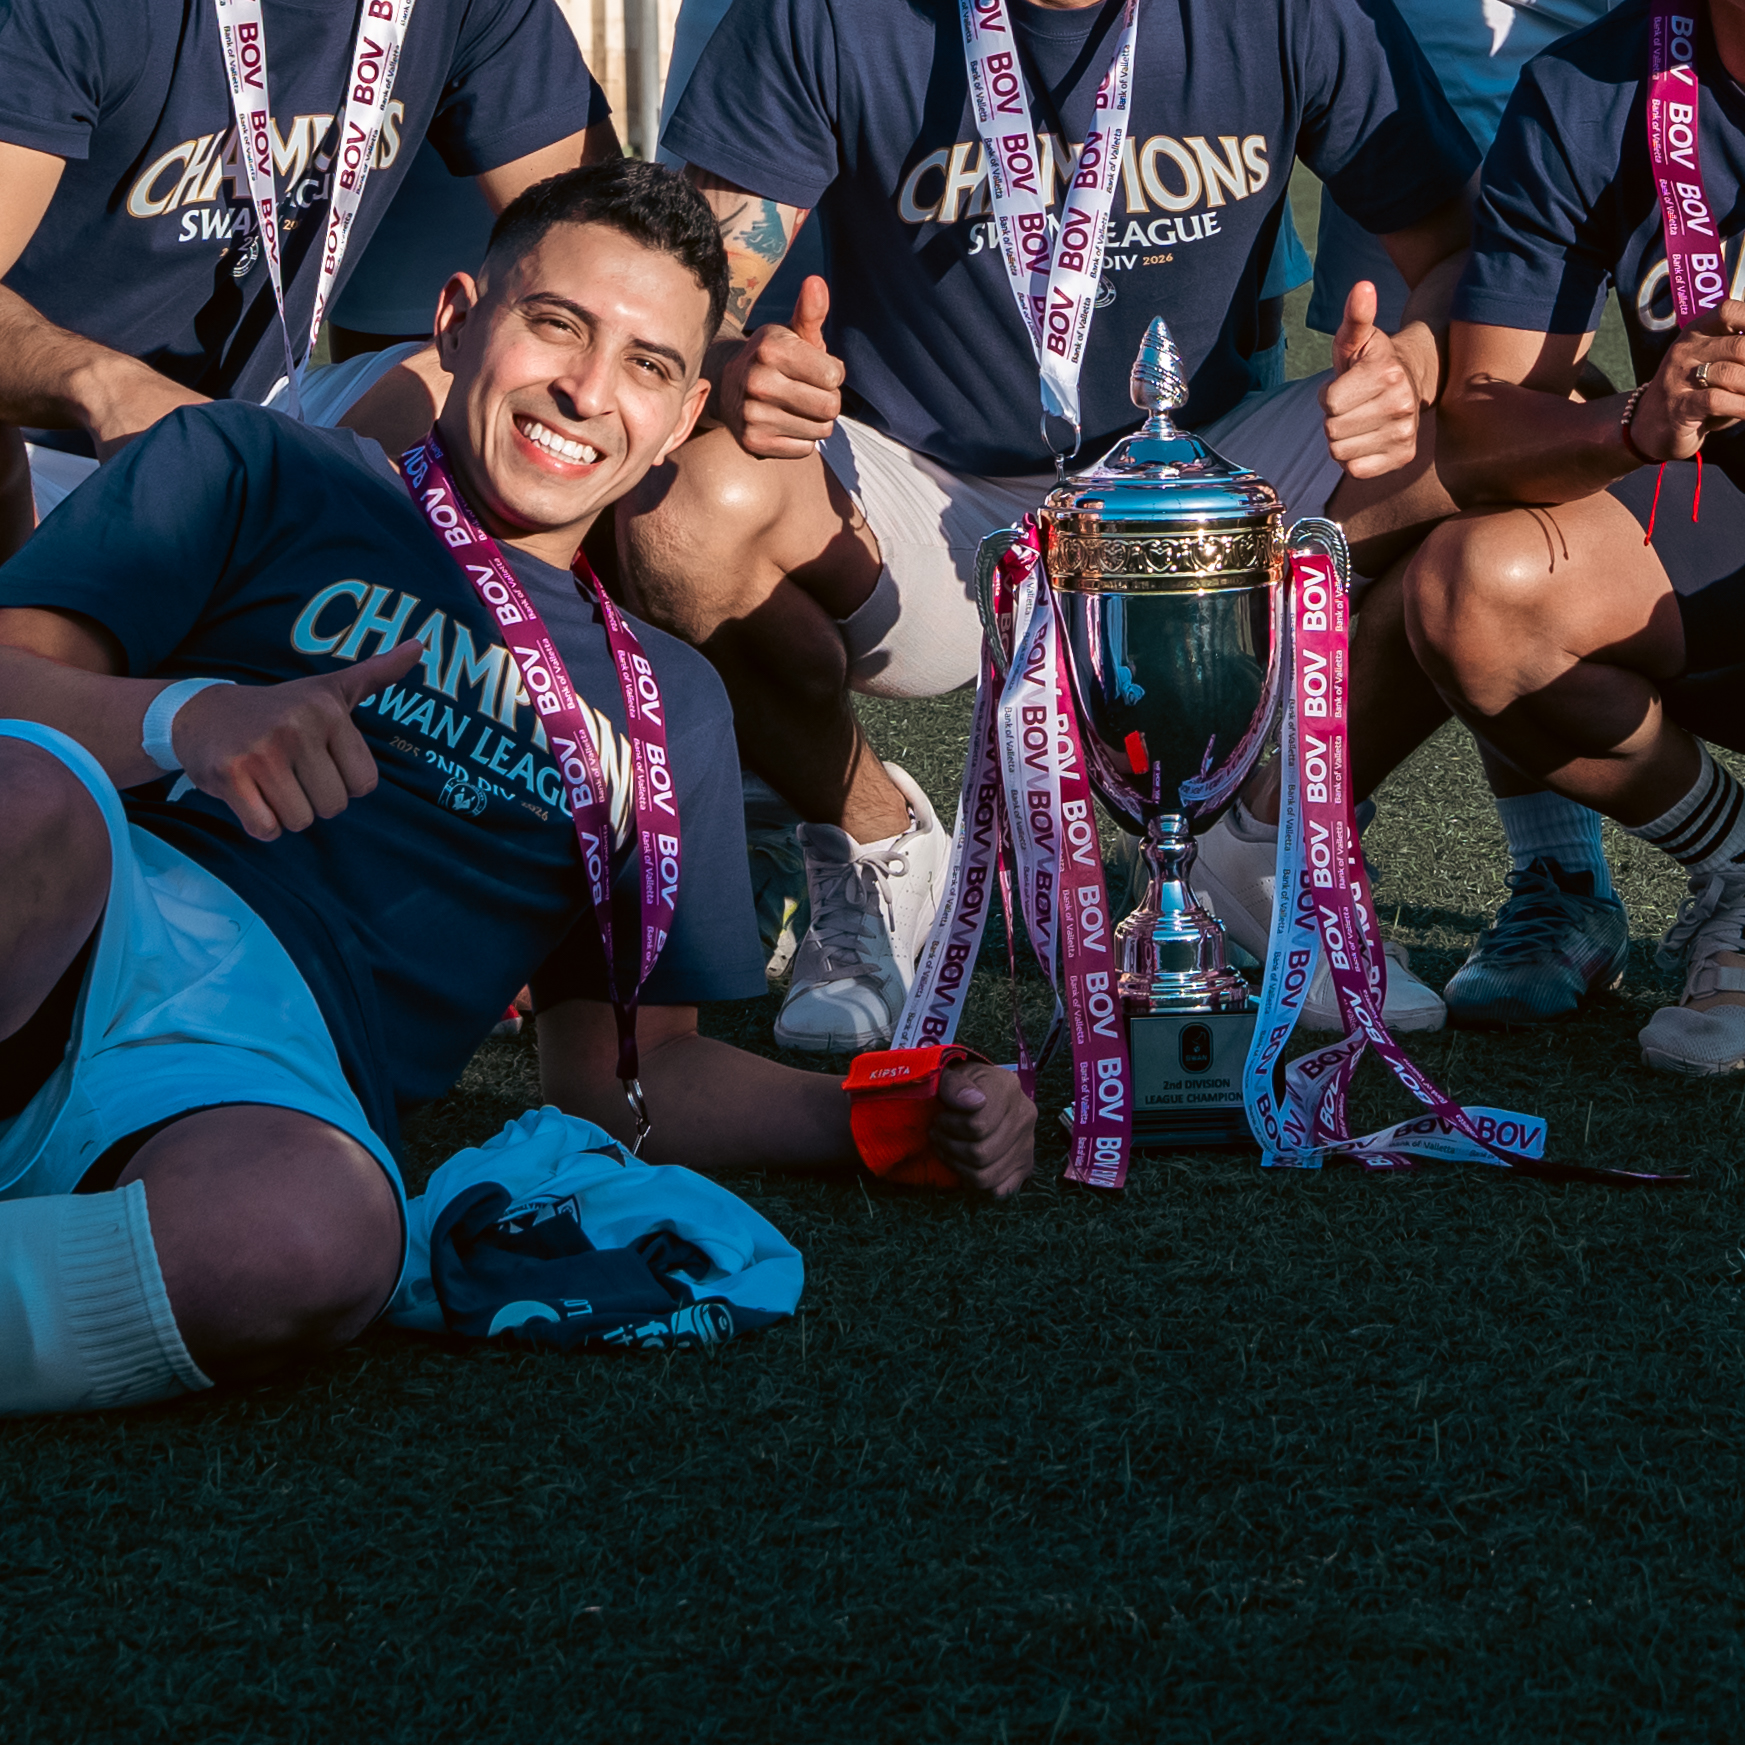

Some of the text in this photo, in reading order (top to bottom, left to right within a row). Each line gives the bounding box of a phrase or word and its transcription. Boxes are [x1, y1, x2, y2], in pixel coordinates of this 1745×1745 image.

[238, 23, 263, 89] BOV
[353, 36, 384, 106] BOV
[1671, 15, 1694, 86] BOV
[987, 52, 1023, 115] BOV
[251, 111, 271, 177] BOV
[340, 121, 366, 191] BOV
[1002, 133, 1037, 195] BOV
[1668, 102, 1695, 170] BOV
[261, 199, 278, 264] BOV
[1058, 207, 1091, 273] BOV
[1676, 181, 1714, 236] BOV
[324, 207, 341, 275] BOV
[1018, 213, 1050, 276] BOV
[1142, 253, 1174, 266] 2026
[1047, 286, 1074, 357] BOV
[1071, 343, 1082, 364] Bank
[1078, 297, 1092, 331] Valletta
[421, 487, 472, 547] BOV
[466, 564, 523, 625] BOV
[1300, 565, 1327, 631] BOV
[513, 646, 562, 715] BOV
[632, 653, 662, 726] BOV
[1303, 649, 1327, 717] BOV
[1335, 650, 1343, 683] Valletta
[359, 684, 471, 749] WAN
[1022, 706, 1049, 773] BOV
[1335, 698, 1343, 717] Bank
[389, 736, 420, 757] 2025
[552, 736, 594, 809] BOV
[1306, 734, 1328, 804] BOV
[1334, 736, 1342, 769] Valletta
[646, 742, 675, 817] BOV
[1286, 784, 1295, 804] Bank
[1334, 784, 1342, 803] Bank
[974, 783, 998, 853] BOV
[1028, 791, 1055, 855] BOV
[1062, 800, 1095, 867] BOV
[1284, 818, 1293, 851] Valletta
[582, 832, 602, 905] BOV
[658, 834, 678, 910] BOV
[1281, 869, 1290, 888] Bank
[1309, 820, 1332, 889] BOV
[958, 867, 987, 931] BOV
[1077, 885, 1106, 953] BOV
[1276, 901, 1287, 934] Valletta
[1319, 904, 1350, 971] BOV
[935, 945, 971, 1006] BOV
[1086, 971, 1118, 1038] BOV
[1282, 949, 1311, 1009] BOV
[1342, 986, 1385, 1045] BOV
[869, 1066, 910, 1079] KIPSTA
[1255, 1022, 1290, 1075] BOV
[1299, 1042, 1353, 1080] BOV
[1383, 1054, 1436, 1106] BOV
[1097, 1057, 1123, 1123] BOV
[1145, 1095, 1183, 1104] LEAGUE
[1163, 1079, 1230, 1090] 2nd DIVISION
[1319, 1068, 1341, 1131] BOV
[1256, 1094, 1294, 1153] BOV
[1422, 1141, 1456, 1155] Valletta
[1477, 1116, 1541, 1149] BOV
